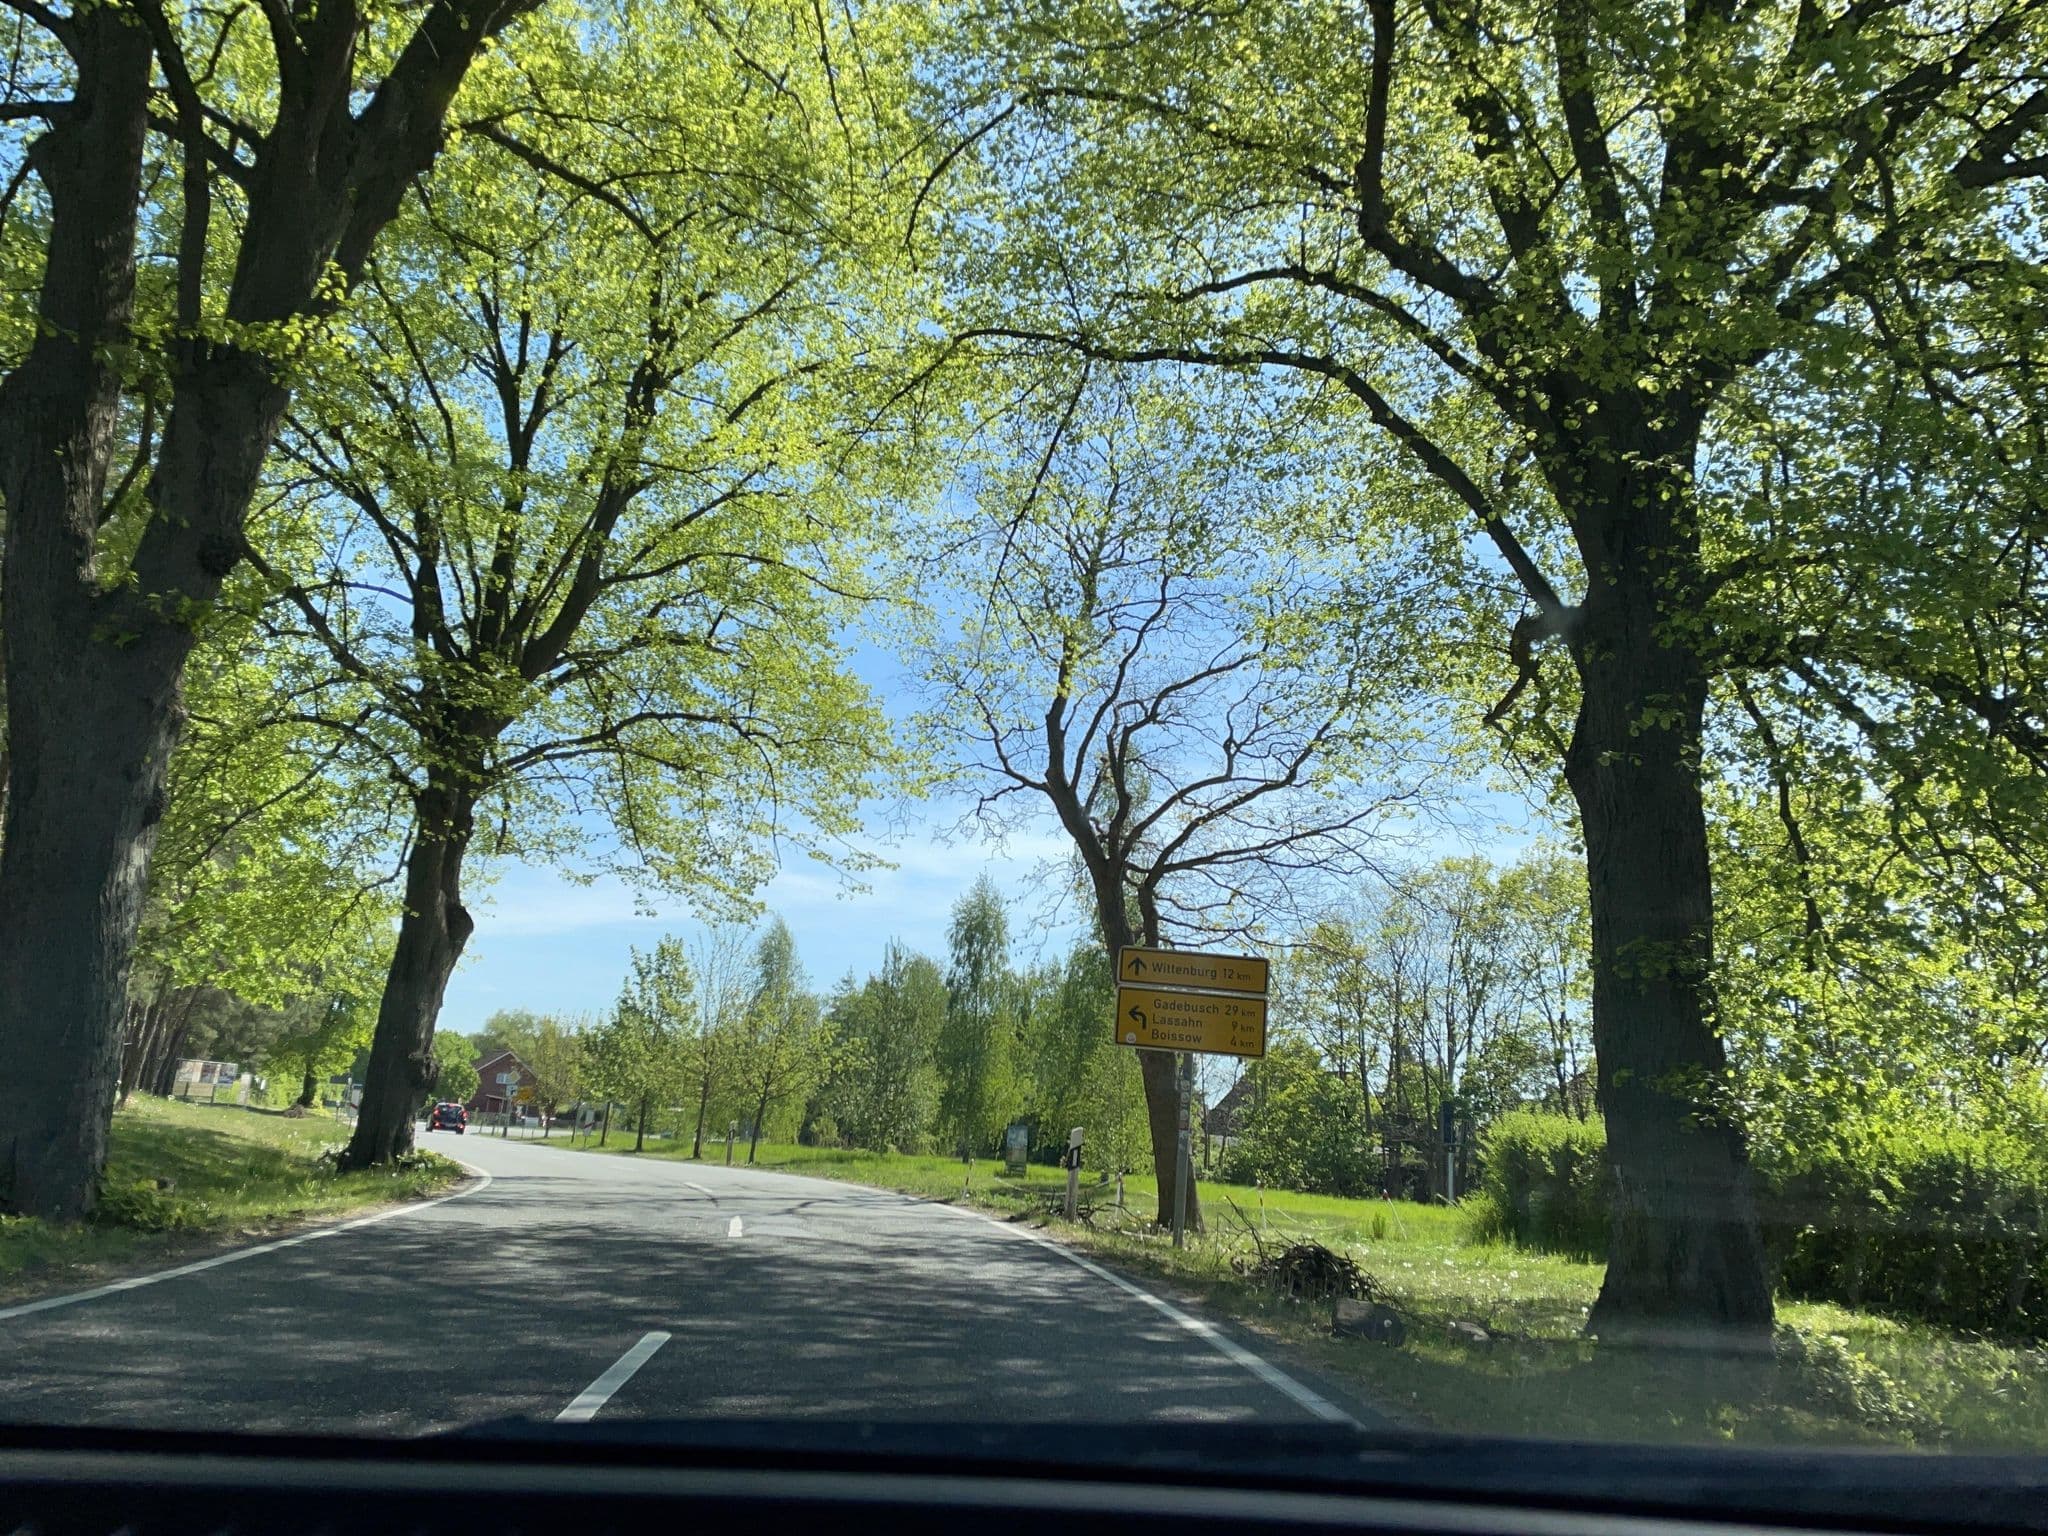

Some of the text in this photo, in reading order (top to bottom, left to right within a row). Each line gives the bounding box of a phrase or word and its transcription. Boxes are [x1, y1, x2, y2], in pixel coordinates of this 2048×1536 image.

[1152, 962, 1251, 981] Wittenburg 12 km
[1154, 999, 1255, 1017] Gadebusch 29 km
[1153, 1014, 1254, 1032] Lassahn 9 km
[1152, 1030, 1202, 1043] Boissow
[1231, 1036, 1237, 1047] 4
